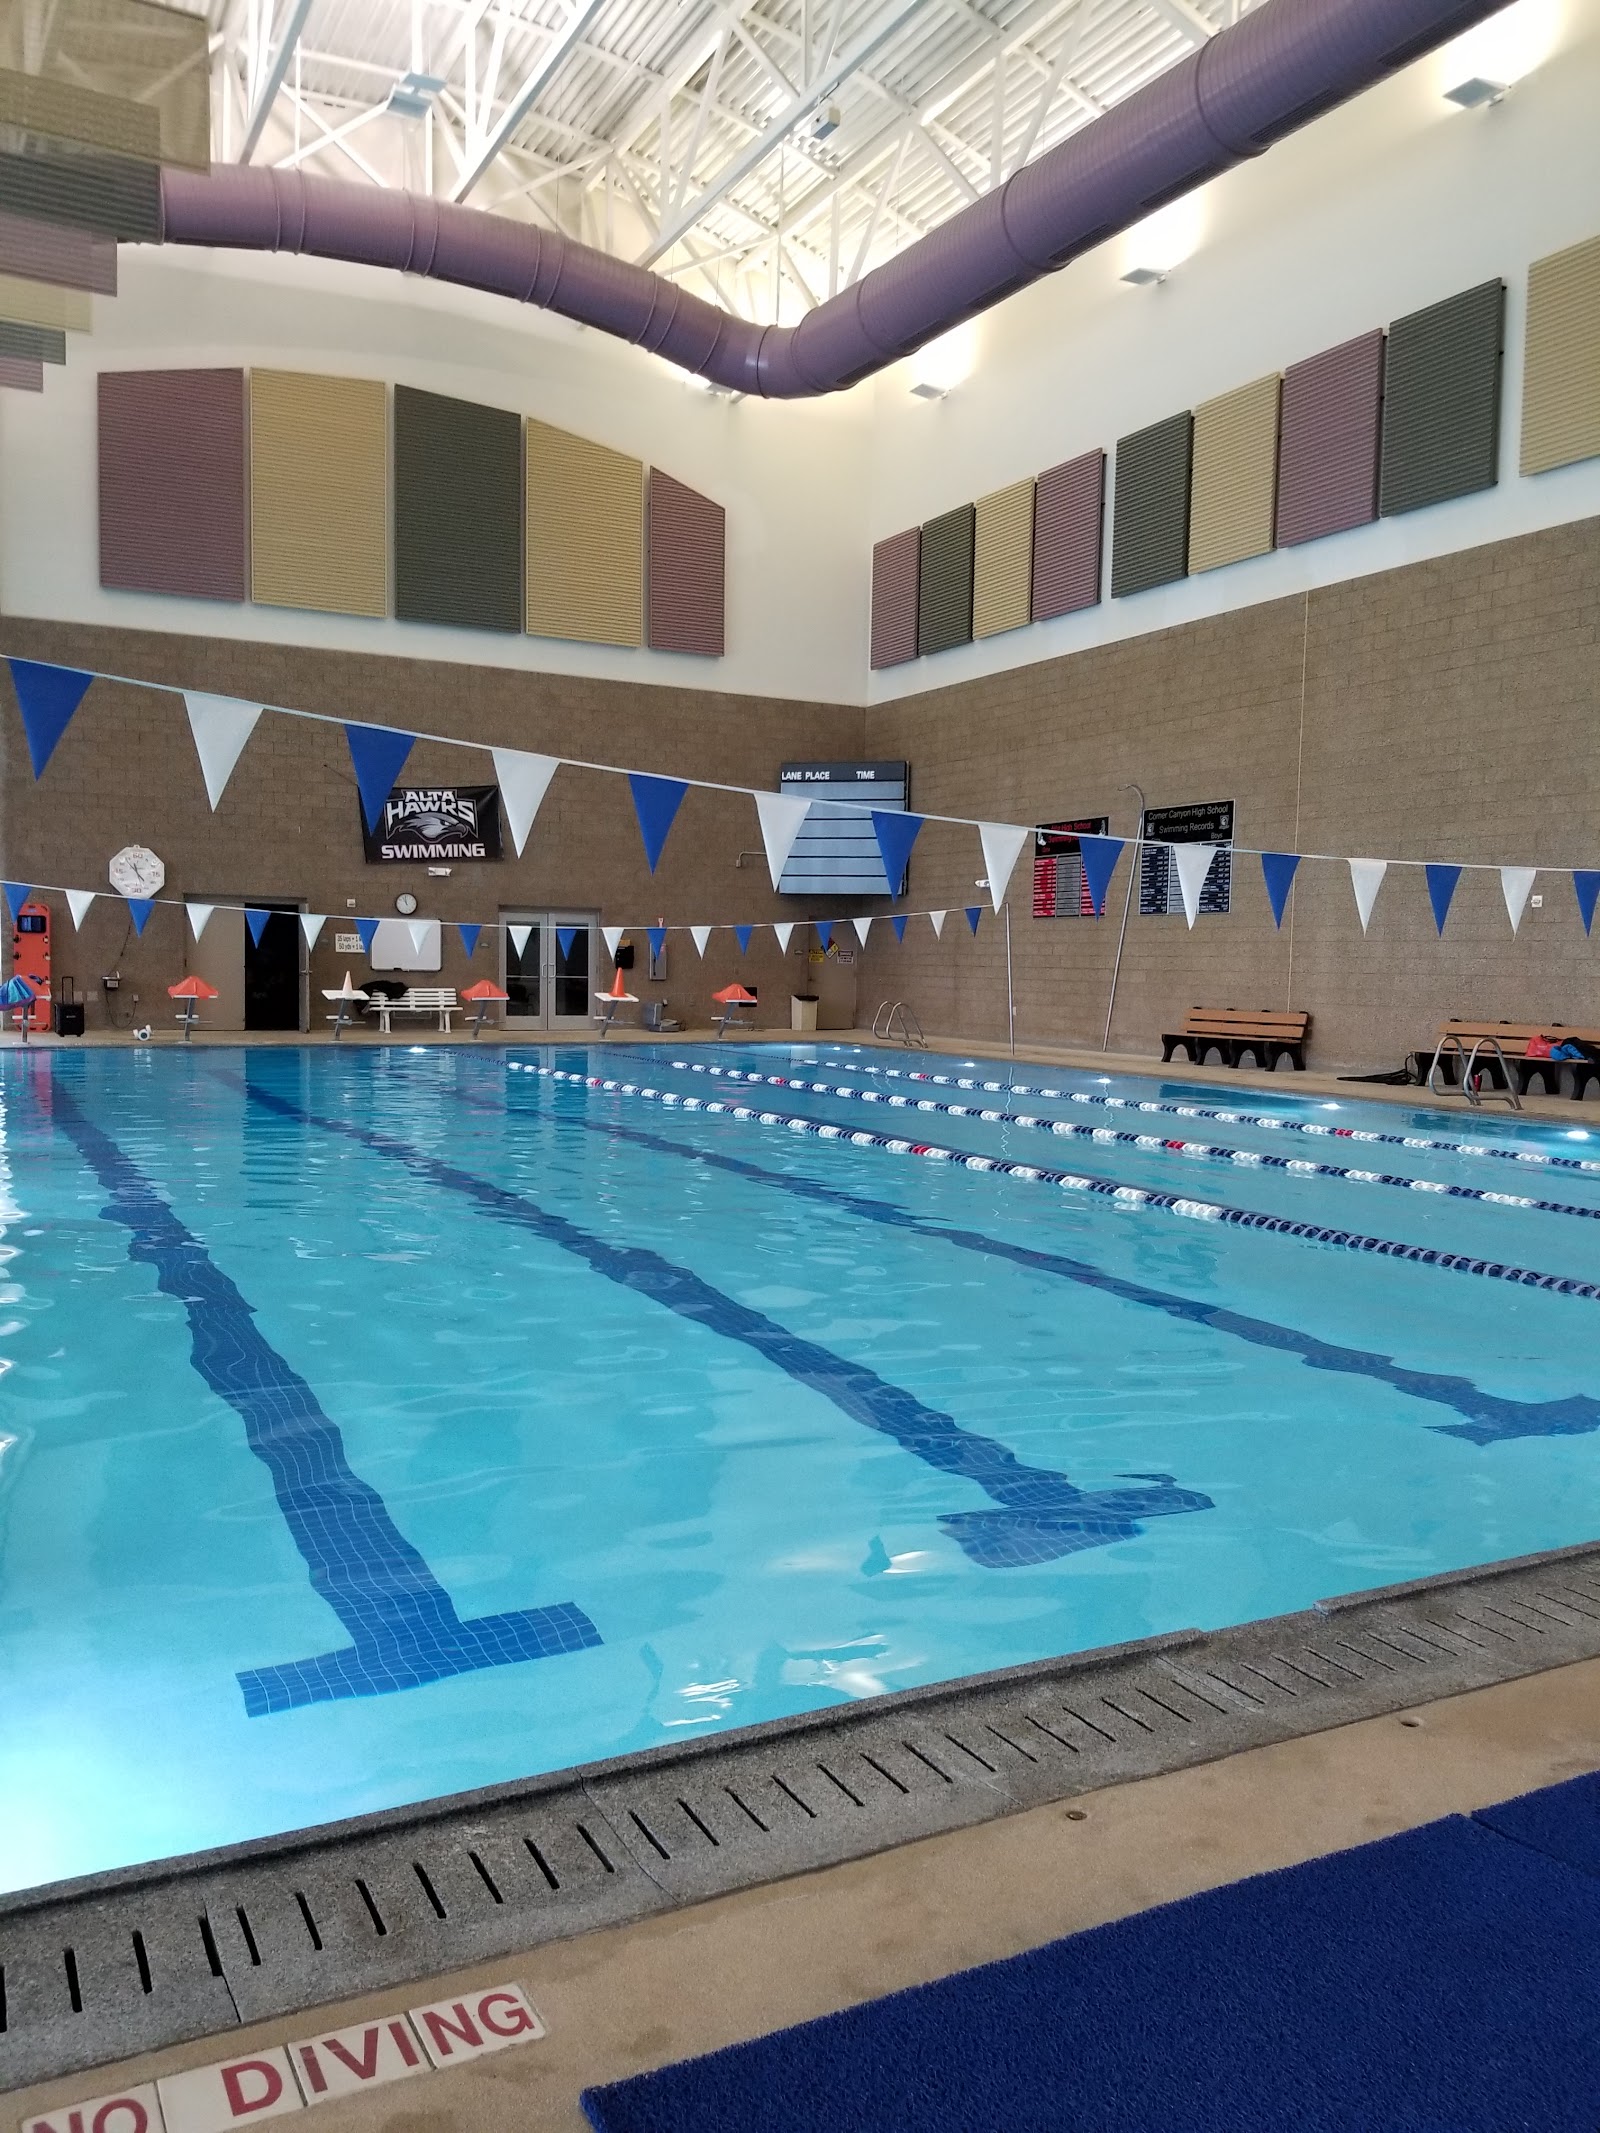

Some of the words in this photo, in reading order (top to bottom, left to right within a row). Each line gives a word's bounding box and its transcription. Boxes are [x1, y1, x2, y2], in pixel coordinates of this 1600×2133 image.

[781, 771, 802, 780] LANE
[805, 771, 830, 780] PLACE
[856, 770, 875, 780] TIME
[405, 791, 456, 803] ALTA
[386, 800, 476, 832] HAWKS
[1168, 809, 1191, 819] Canyon
[1191, 807, 1206, 817] High
[1207, 804, 1229, 815] School
[1074, 821, 1092, 831] School
[1159, 823, 1188, 834] Swimming
[1189, 821, 1215, 831] Records
[381, 843, 486, 859] SWIMMING
[221, 1993, 535, 2117] DIVING
